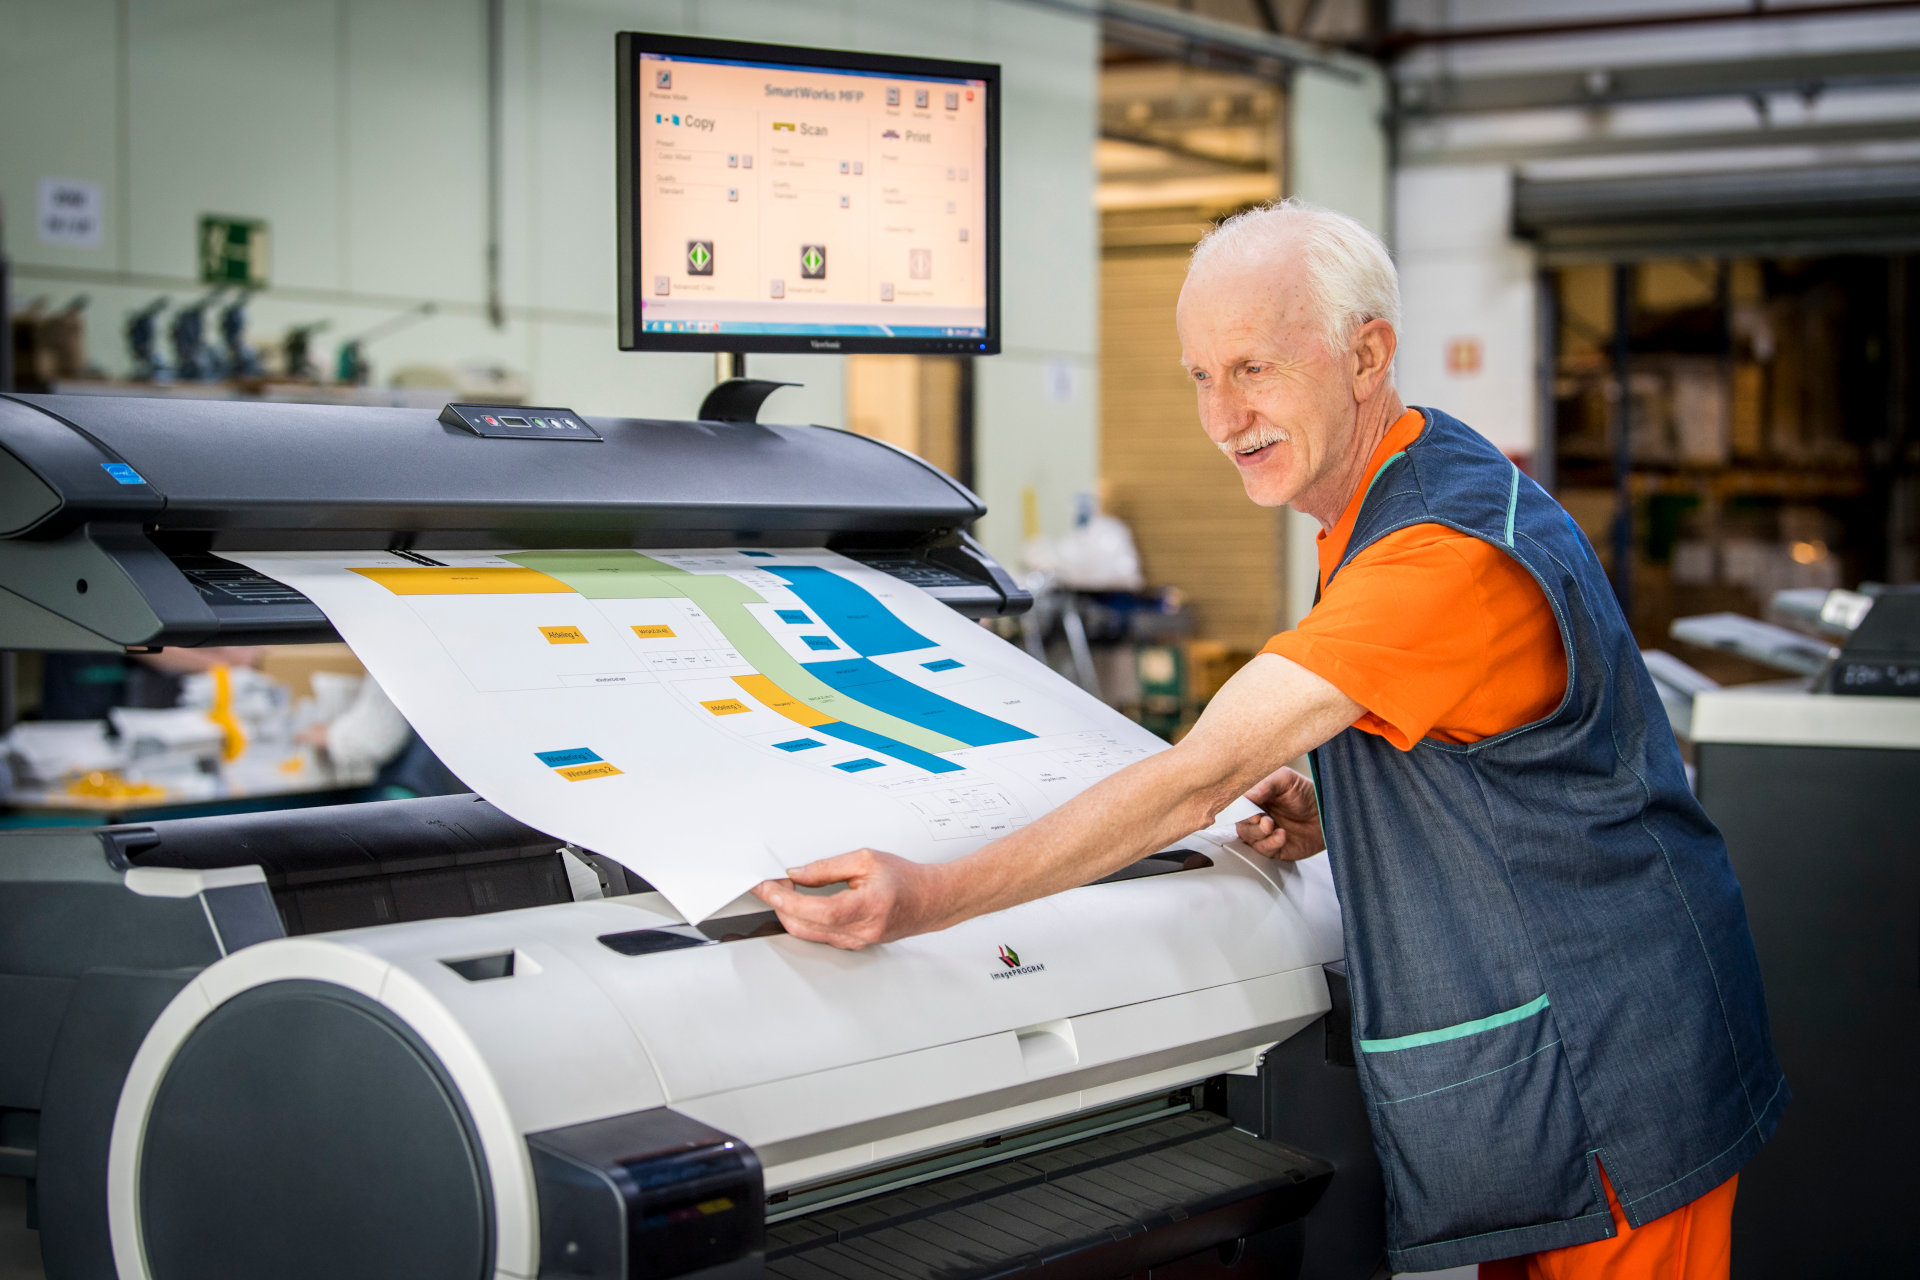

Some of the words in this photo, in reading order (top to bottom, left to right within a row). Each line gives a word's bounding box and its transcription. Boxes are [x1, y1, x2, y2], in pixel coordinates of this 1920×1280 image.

[764, 84, 836, 101] SmartWorks
[839, 89, 865, 104] MFP
[685, 114, 716, 132] Copy
[800, 122, 829, 137] Scan
[905, 130, 932, 144] Print
[990, 963, 1046, 980] imagePROGRAF
